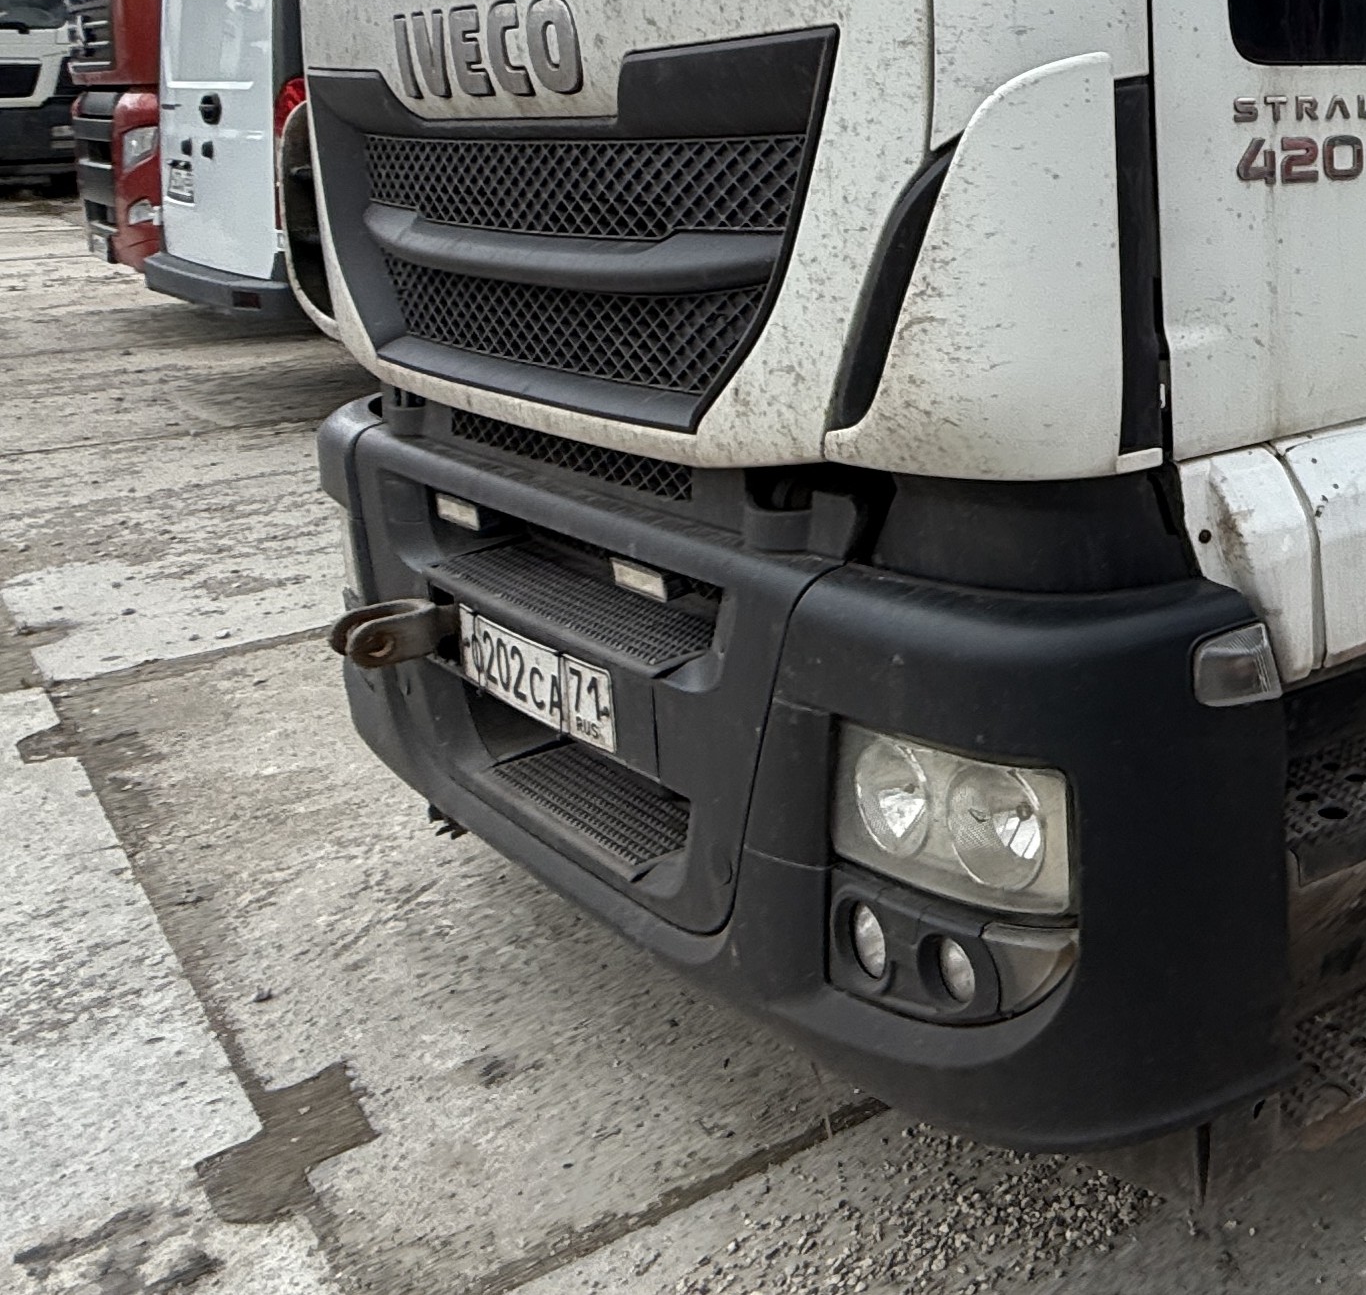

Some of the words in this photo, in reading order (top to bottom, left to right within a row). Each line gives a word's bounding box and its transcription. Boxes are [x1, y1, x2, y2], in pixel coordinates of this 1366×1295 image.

[1236, 134, 1364, 185] 420
[569, 666, 601, 721] 71
[575, 715, 600, 739] RUS
